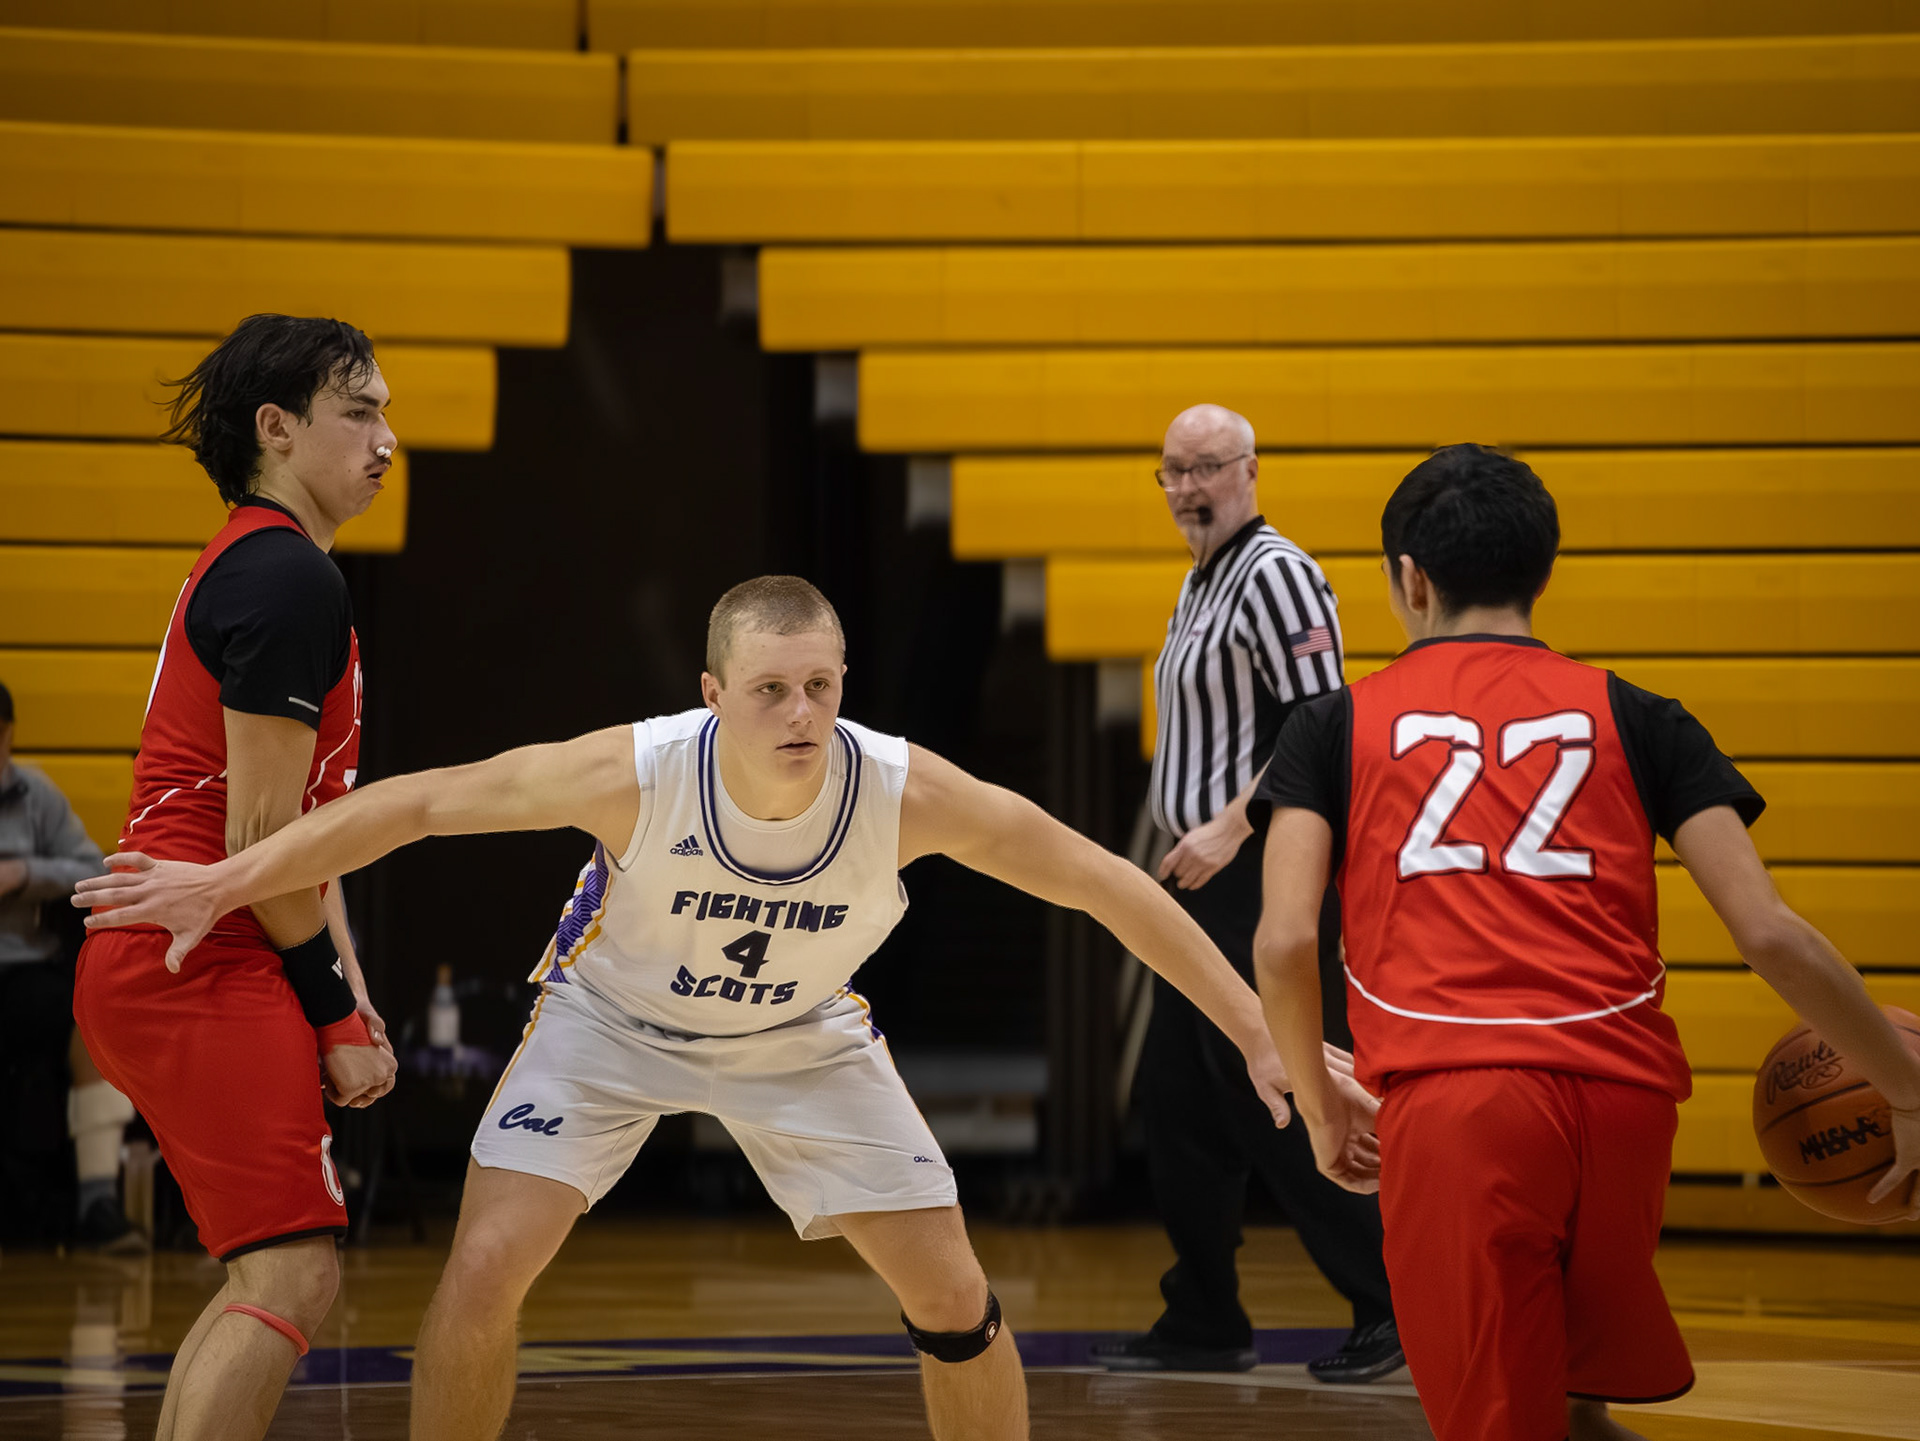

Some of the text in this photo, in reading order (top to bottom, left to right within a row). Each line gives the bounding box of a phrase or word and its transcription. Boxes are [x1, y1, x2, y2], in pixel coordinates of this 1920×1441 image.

[1391, 709, 1596, 883] 22
[670, 847, 704, 857] adidas
[670, 890, 849, 932] FIGHTING
[721, 930, 772, 979] 4
[670, 965, 798, 1005] SCOTS
[498, 1103, 564, 1136] Cal
